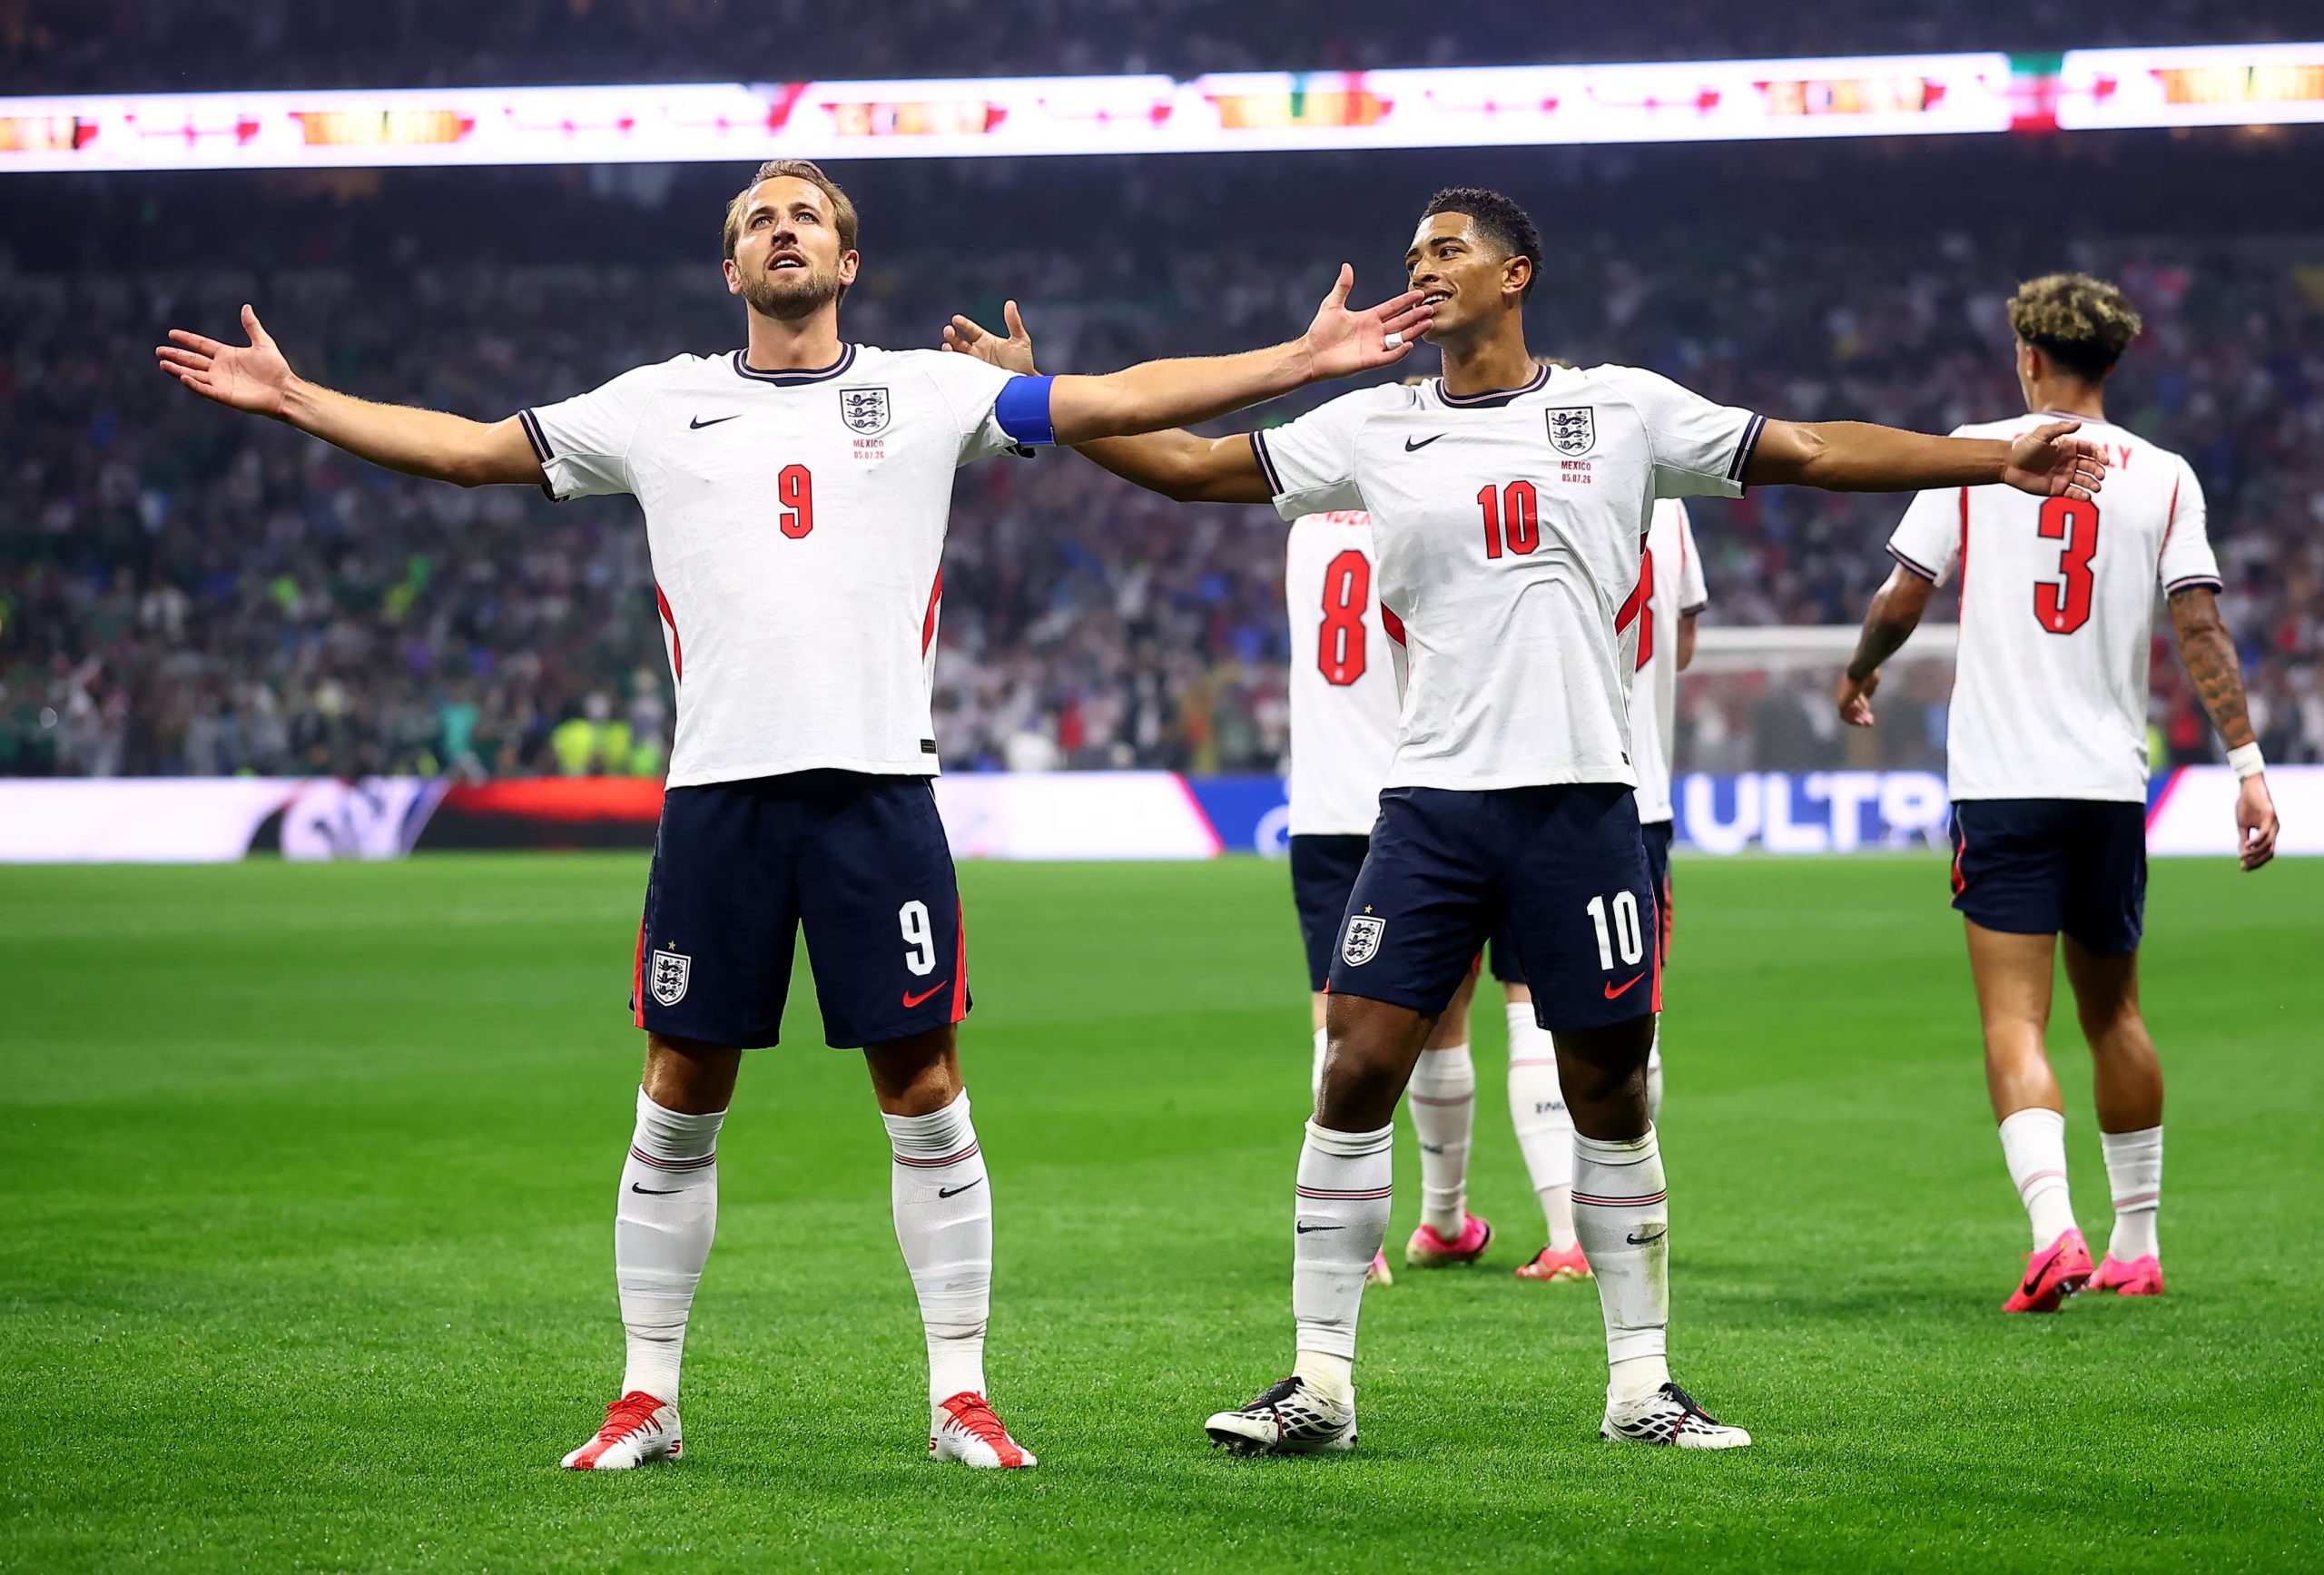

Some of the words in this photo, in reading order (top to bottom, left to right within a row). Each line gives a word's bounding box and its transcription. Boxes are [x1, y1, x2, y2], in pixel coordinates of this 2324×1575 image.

[853, 438, 884, 448] MEXICO
[853, 450, 885, 459] 05.07.26
[1561, 459, 1591, 471] MEXICO
[1561, 473, 1591, 484] 05.07.26
[778, 464, 813, 539] 9
[1476, 479, 1541, 559] 10
[2034, 495, 2100, 635] 3
[1318, 549, 1371, 686] 8
[1683, 773, 1951, 853] ULTR
[898, 900, 936, 977] 9
[1586, 890, 1644, 970] 10
